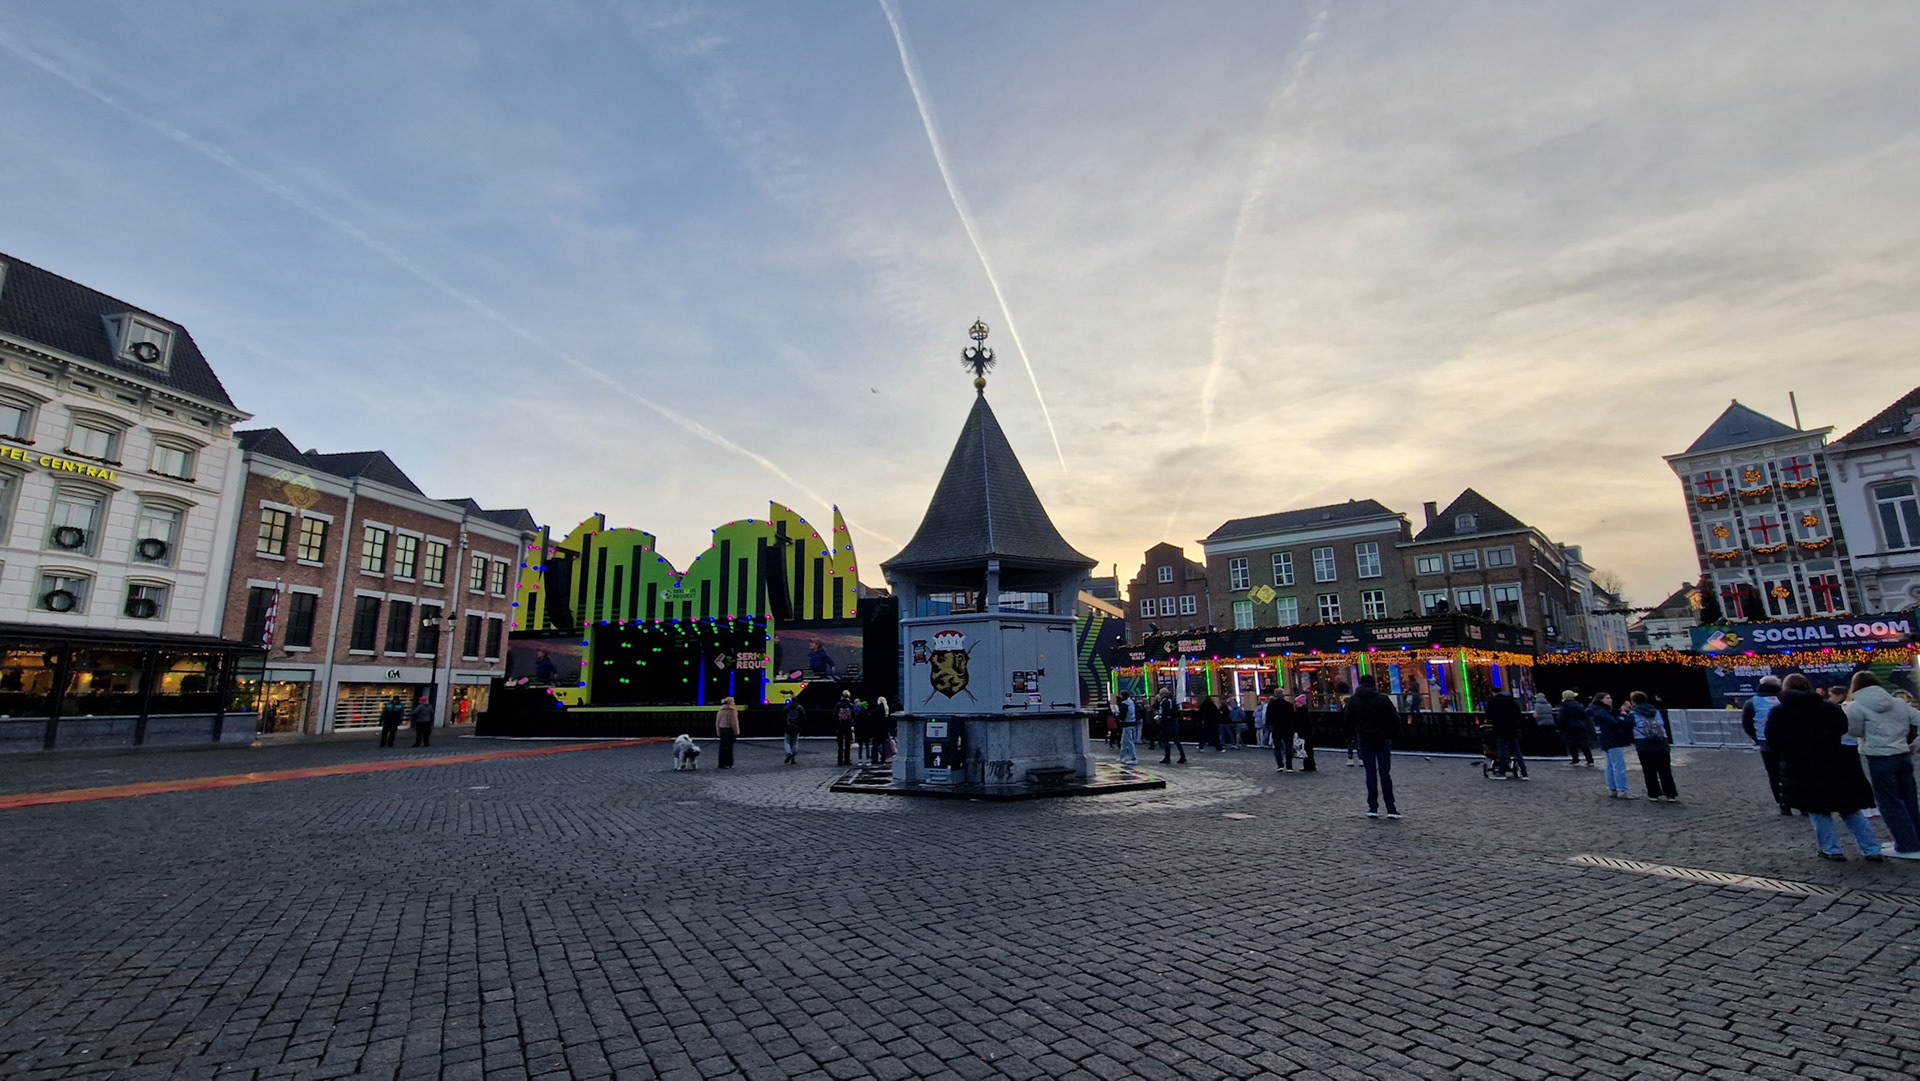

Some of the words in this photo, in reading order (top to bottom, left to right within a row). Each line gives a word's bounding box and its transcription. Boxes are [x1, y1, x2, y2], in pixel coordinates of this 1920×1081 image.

[0, 446, 32, 463] TEL
[40, 456, 118, 481] CENTRAL
[1753, 625, 1834, 643] SOCIAL
[1837, 620, 1911, 638] ROOM
[736, 661, 767, 669] REQUE
